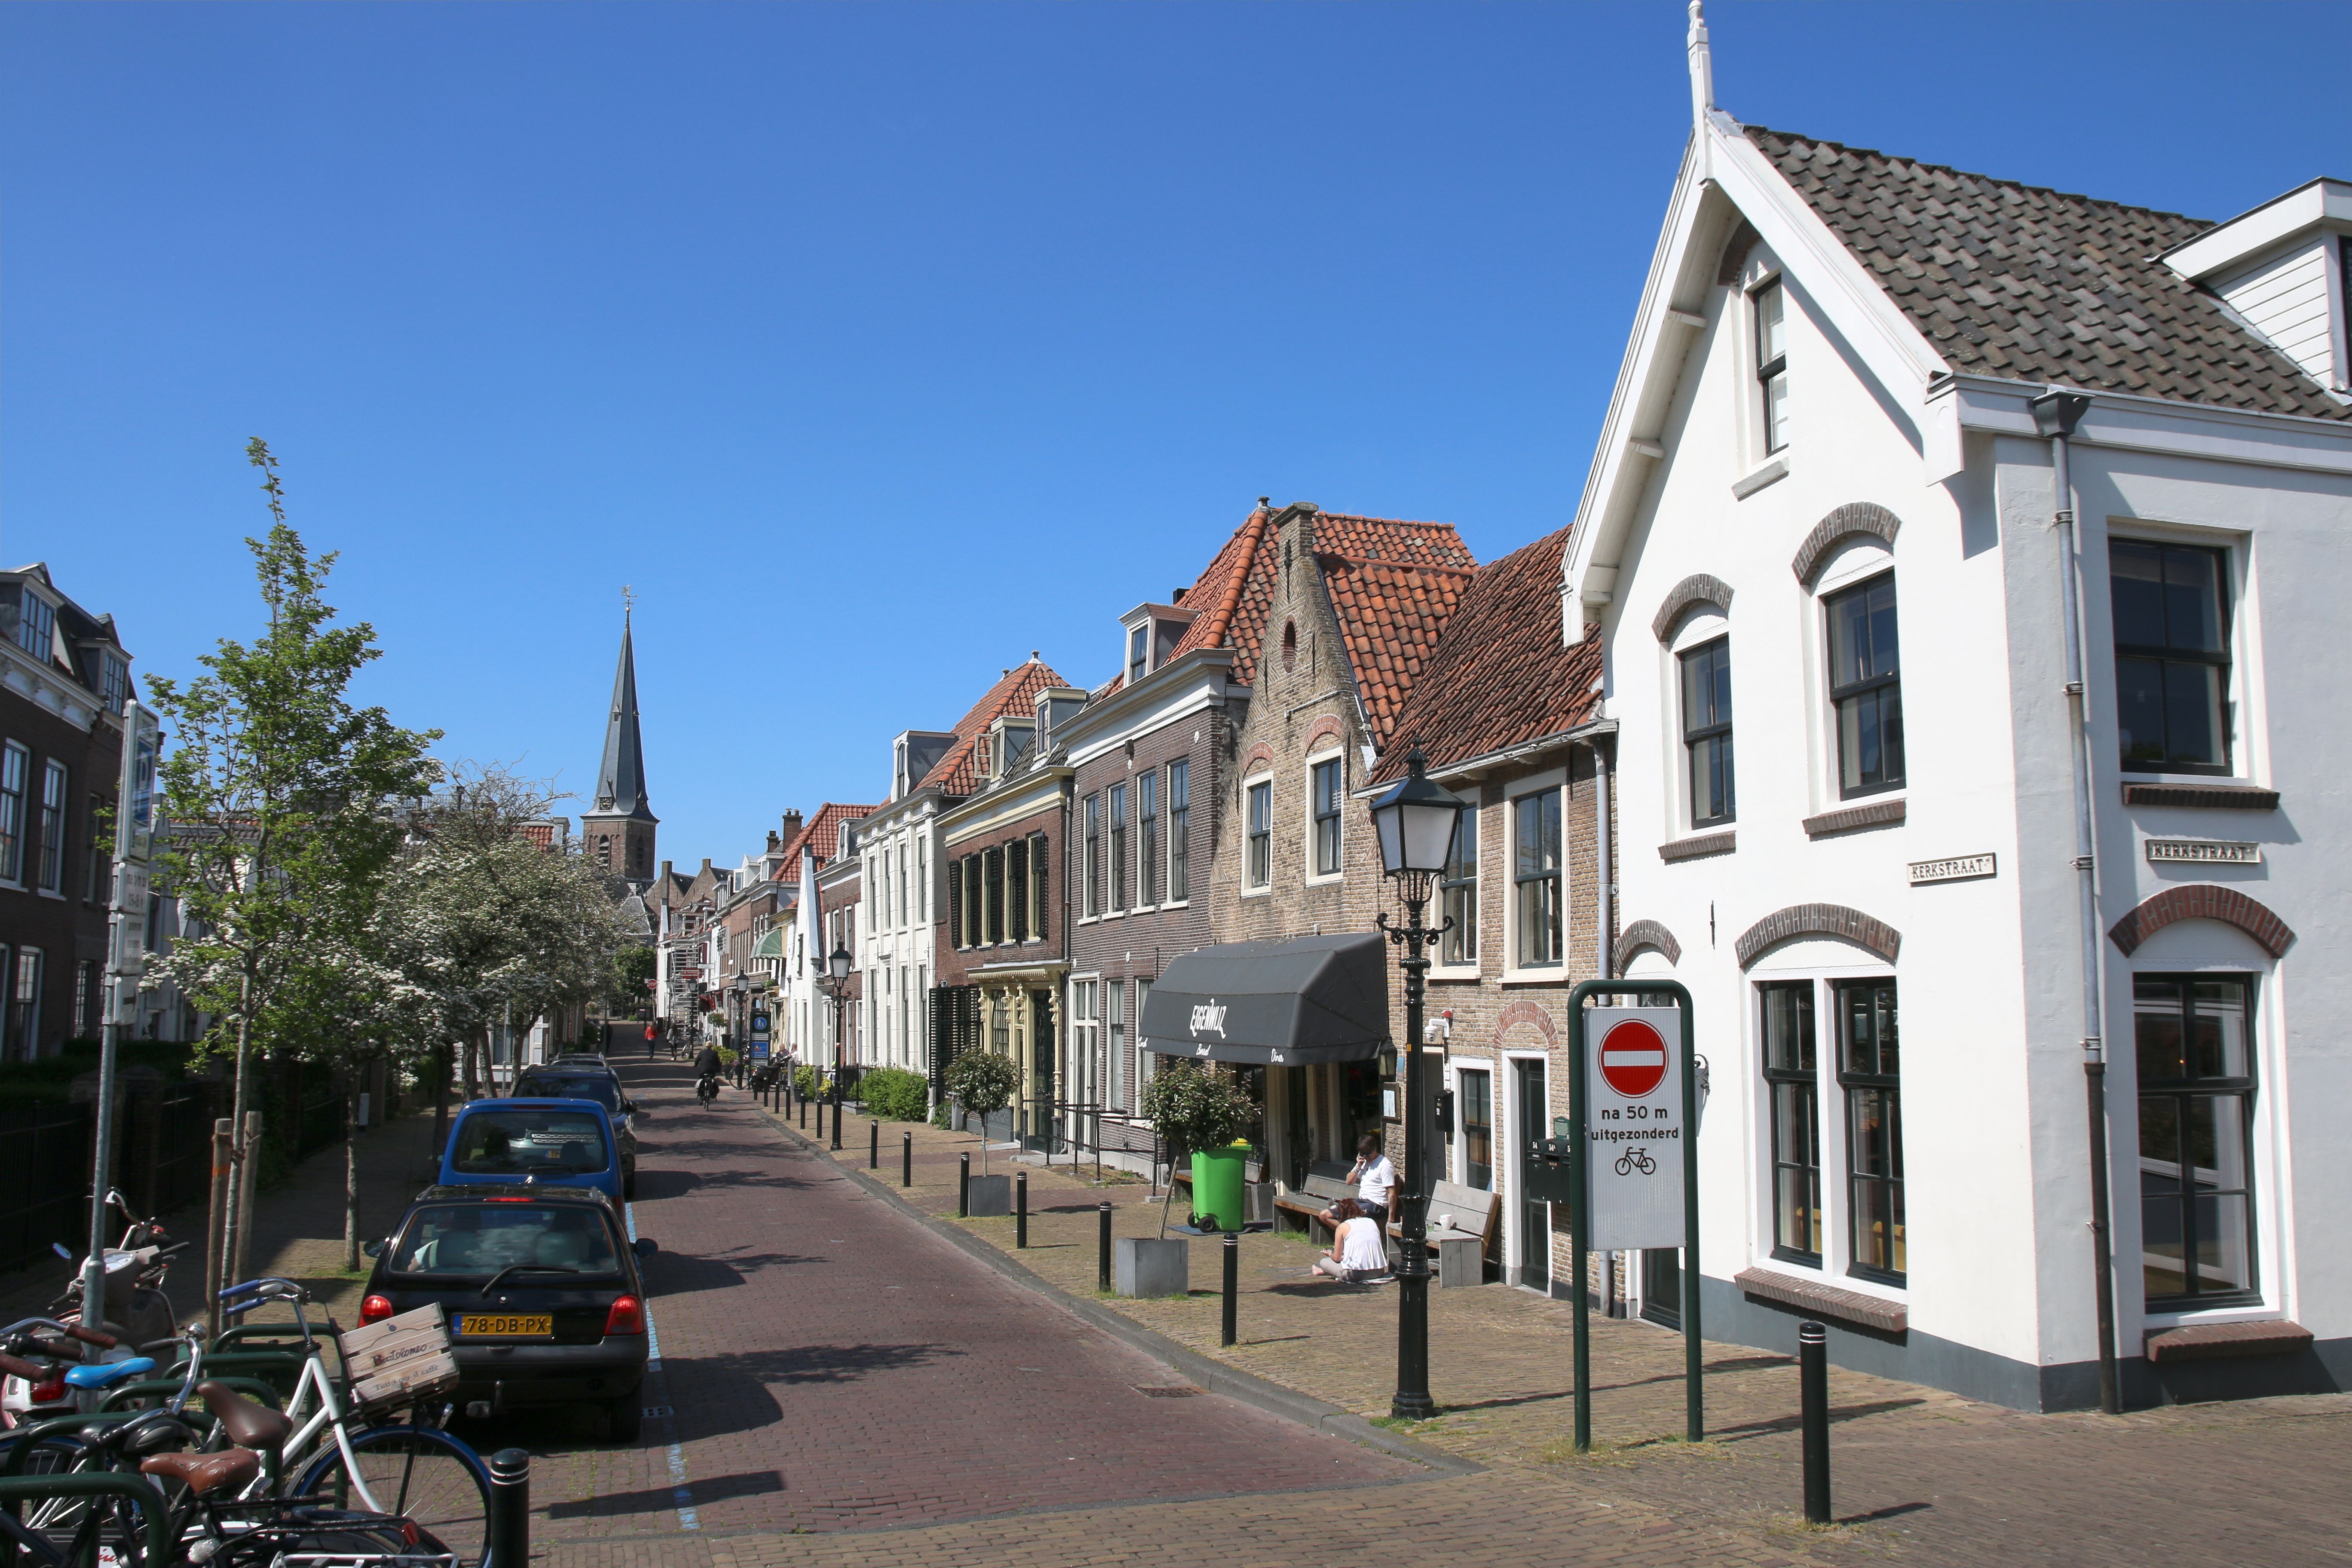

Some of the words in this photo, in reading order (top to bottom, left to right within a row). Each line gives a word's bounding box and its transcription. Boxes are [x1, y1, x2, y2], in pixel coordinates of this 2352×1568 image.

[2153, 843, 2246, 860] KERKSTRAAT
[1912, 858, 1983, 879] KERKSTRAAT
[1190, 998, 1227, 1039] EIGENWIJZ
[1271, 1048, 1284, 1063] Diner
[1602, 1109, 1620, 1120] na
[1627, 1106, 1648, 1119] 50
[1654, 1108, 1667, 1118] m
[1591, 1127, 1678, 1143] uitgezonderd
[467, 1317, 546, 1332] 78-DB-PX
[371, 1344, 427, 1368] Bartolomeo
